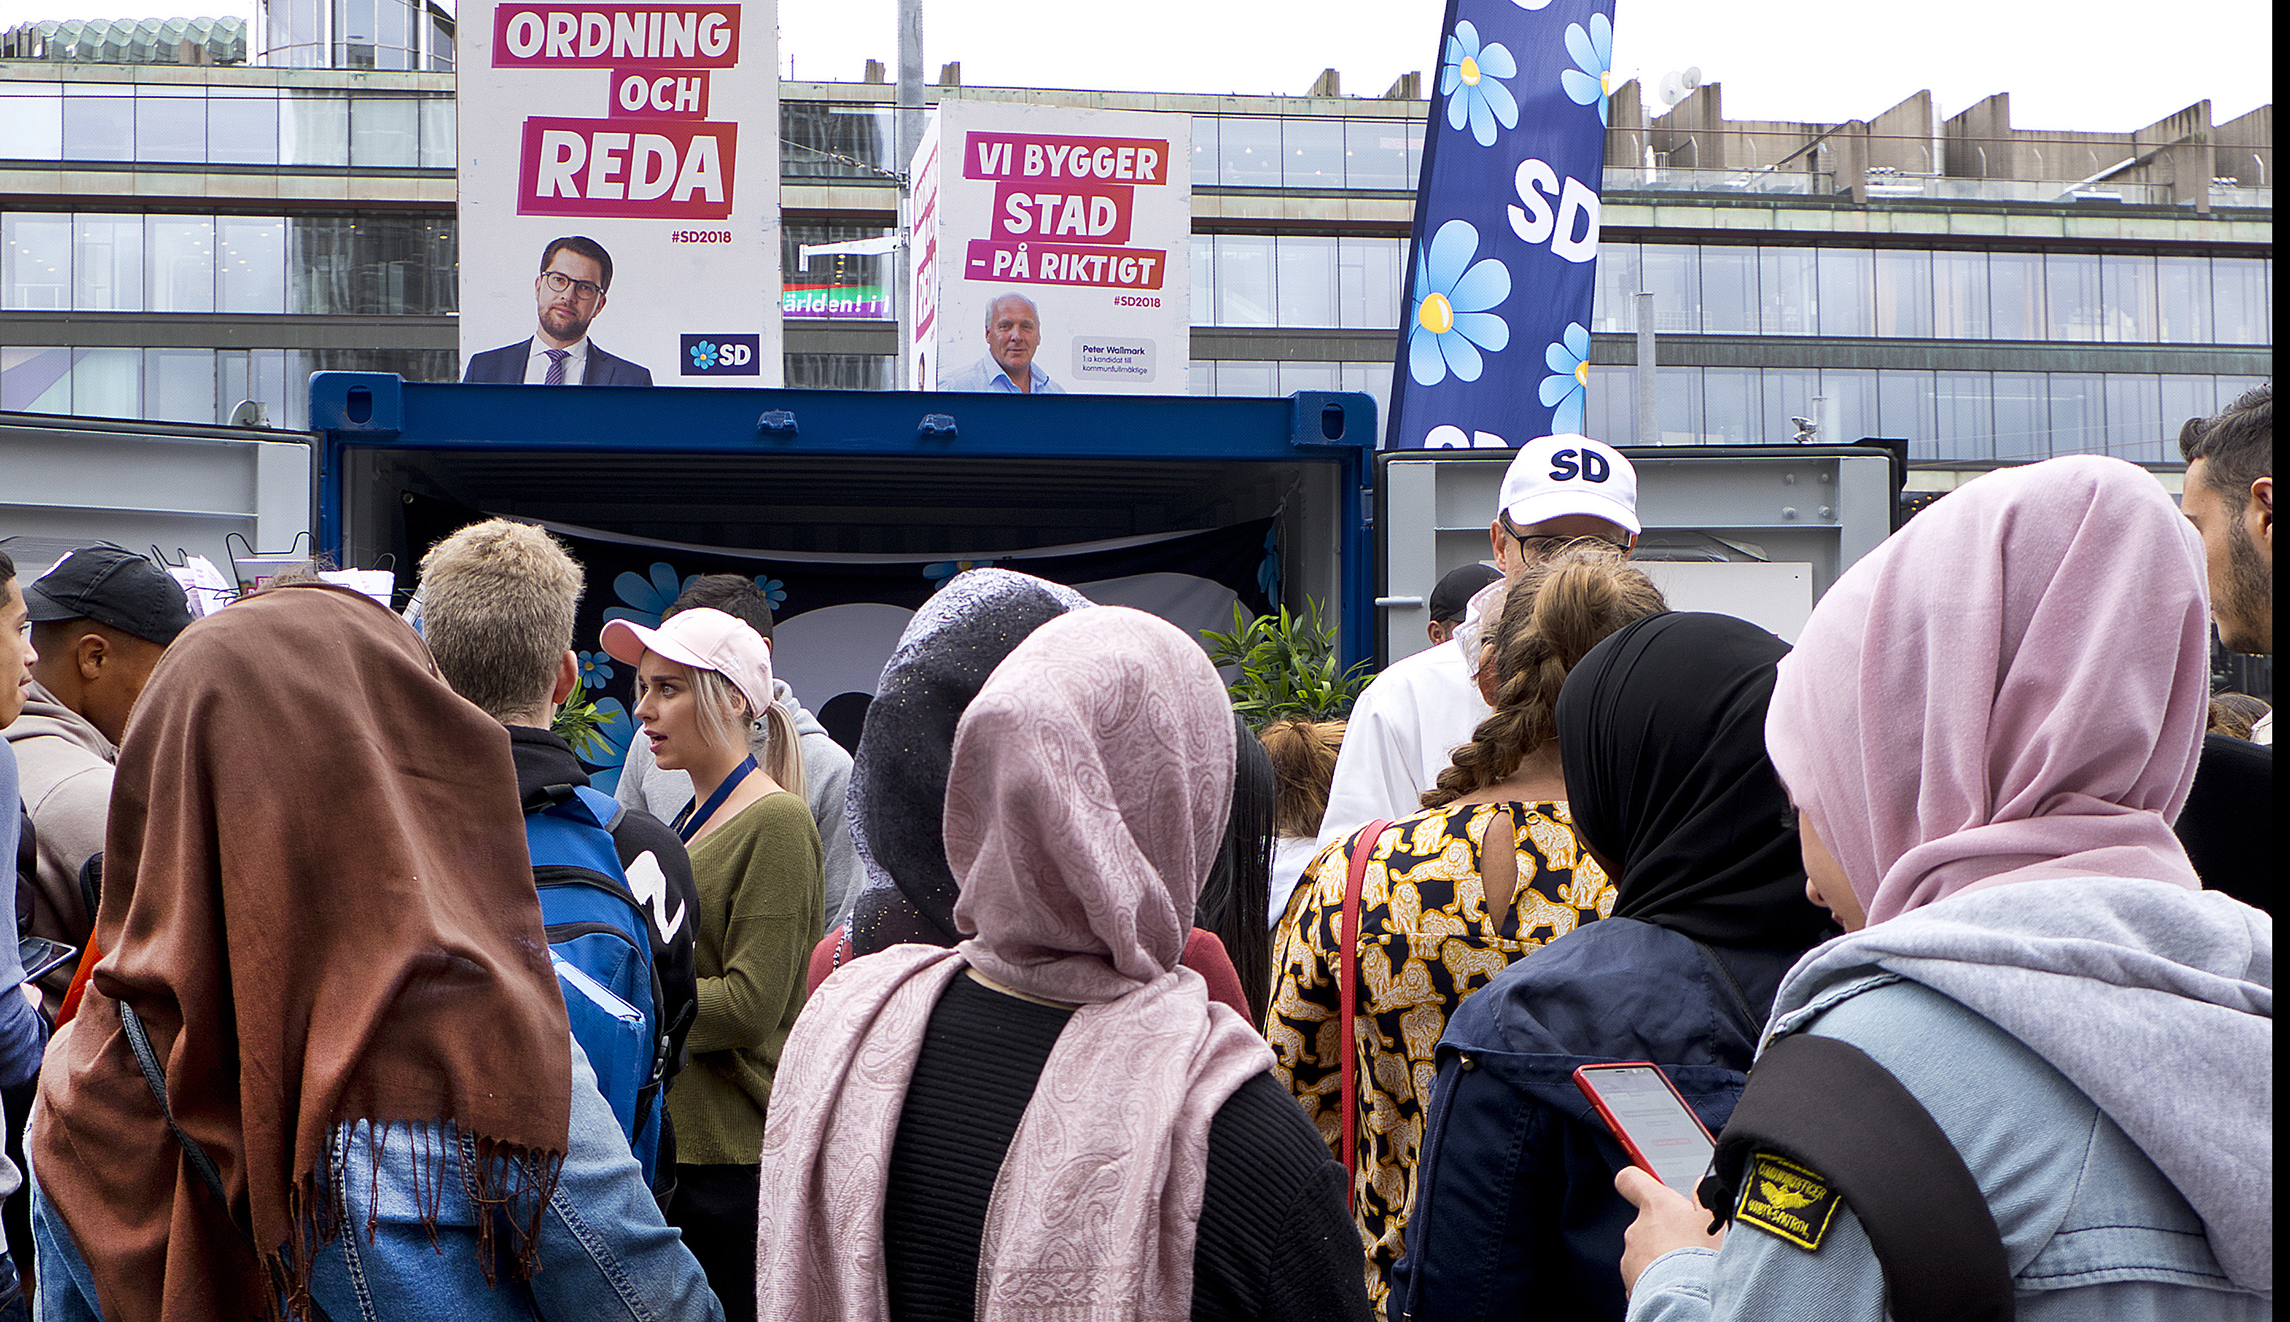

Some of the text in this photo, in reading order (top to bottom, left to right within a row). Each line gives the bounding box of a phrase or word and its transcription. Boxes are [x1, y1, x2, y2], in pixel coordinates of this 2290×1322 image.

[506, 11, 731, 58] ORDNING
[619, 75, 701, 112] OCH
[536, 130, 724, 202] REDA
[977, 142, 1158, 180] VI BYGGER
[1003, 192, 1117, 236] STAD
[1507, 158, 1600, 264] SD
[671, 230, 732, 243] #SD2018
[992, 242, 1030, 279] PÅ
[1039, 252, 1156, 285] RIKTIGT
[1113, 296, 1161, 308] #SD2018
[718, 343, 752, 366] SD
[1082, 344, 1145, 355] Peter Wallmark
[1548, 448, 1610, 483] SD
